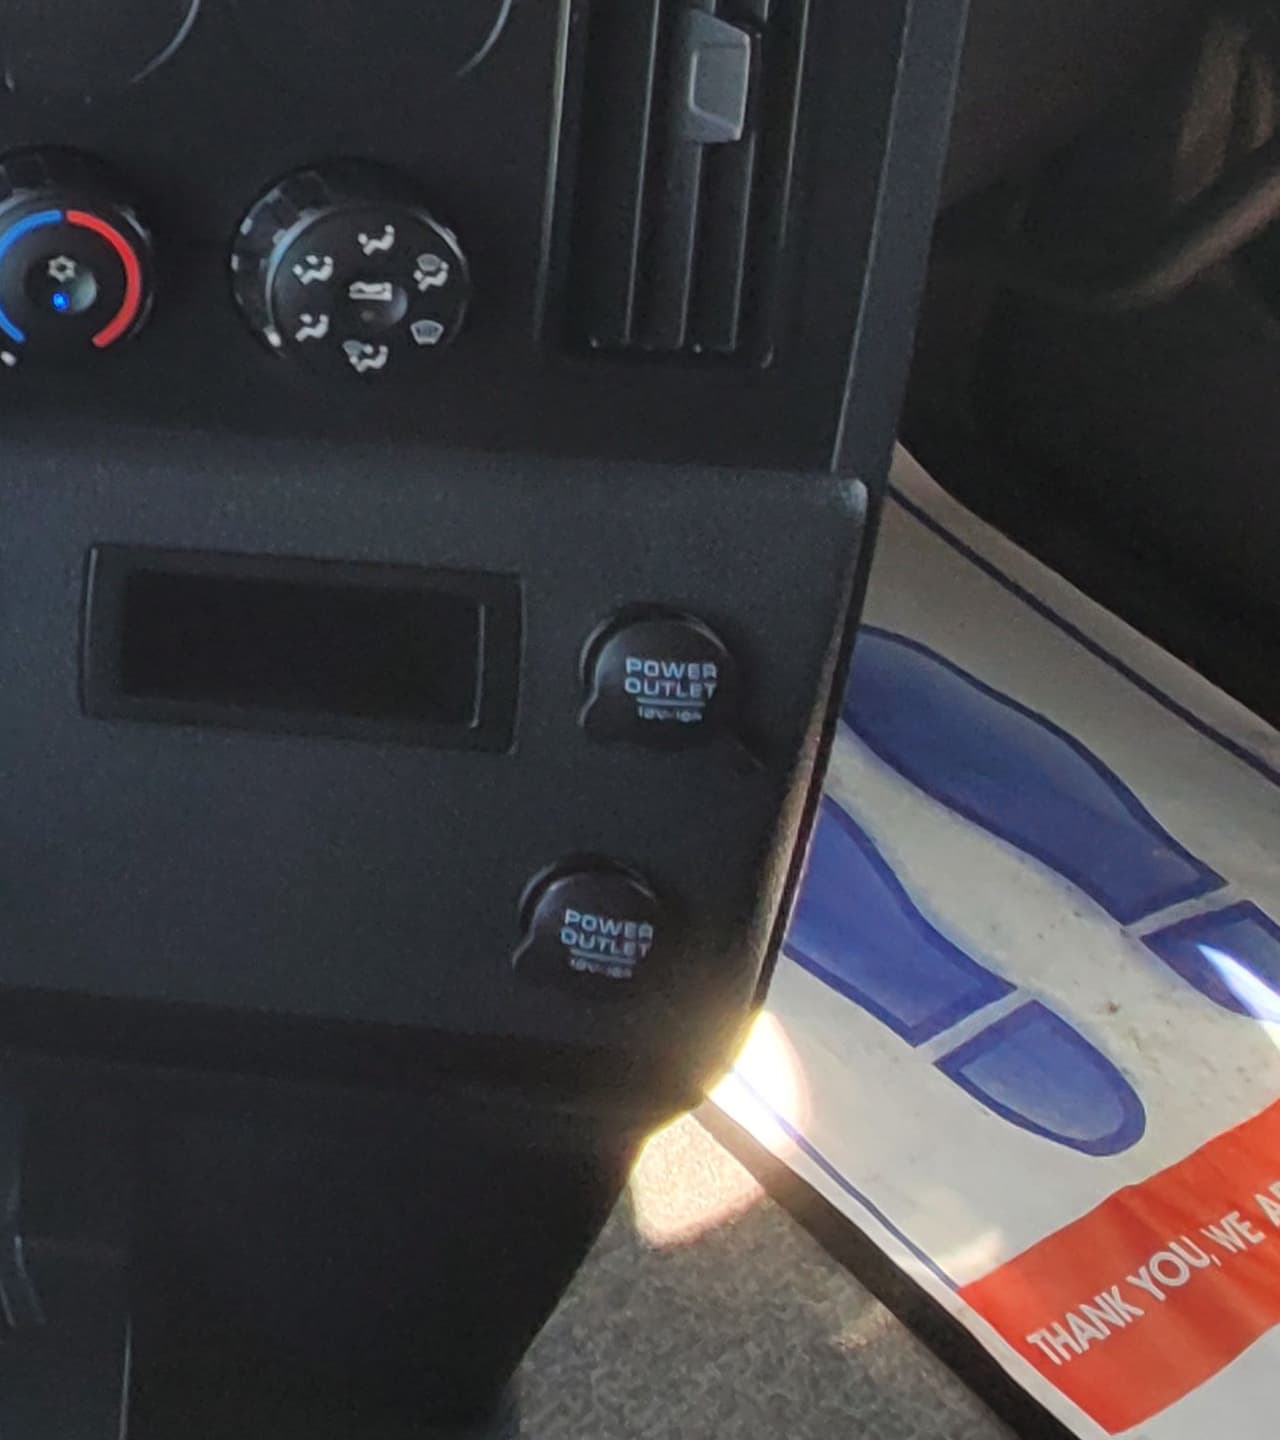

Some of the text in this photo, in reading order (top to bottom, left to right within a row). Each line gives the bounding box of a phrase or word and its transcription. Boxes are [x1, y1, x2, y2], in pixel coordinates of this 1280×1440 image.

[625, 656, 718, 680] POWER
[624, 677, 717, 699] OUTLET
[564, 908, 653, 940] POWER
[560, 926, 652, 958] OUTLET
[1026, 1284, 1145, 1366] THANK
[1125, 1235, 1222, 1302] YOU,
[1199, 1210, 1267, 1254] WE
